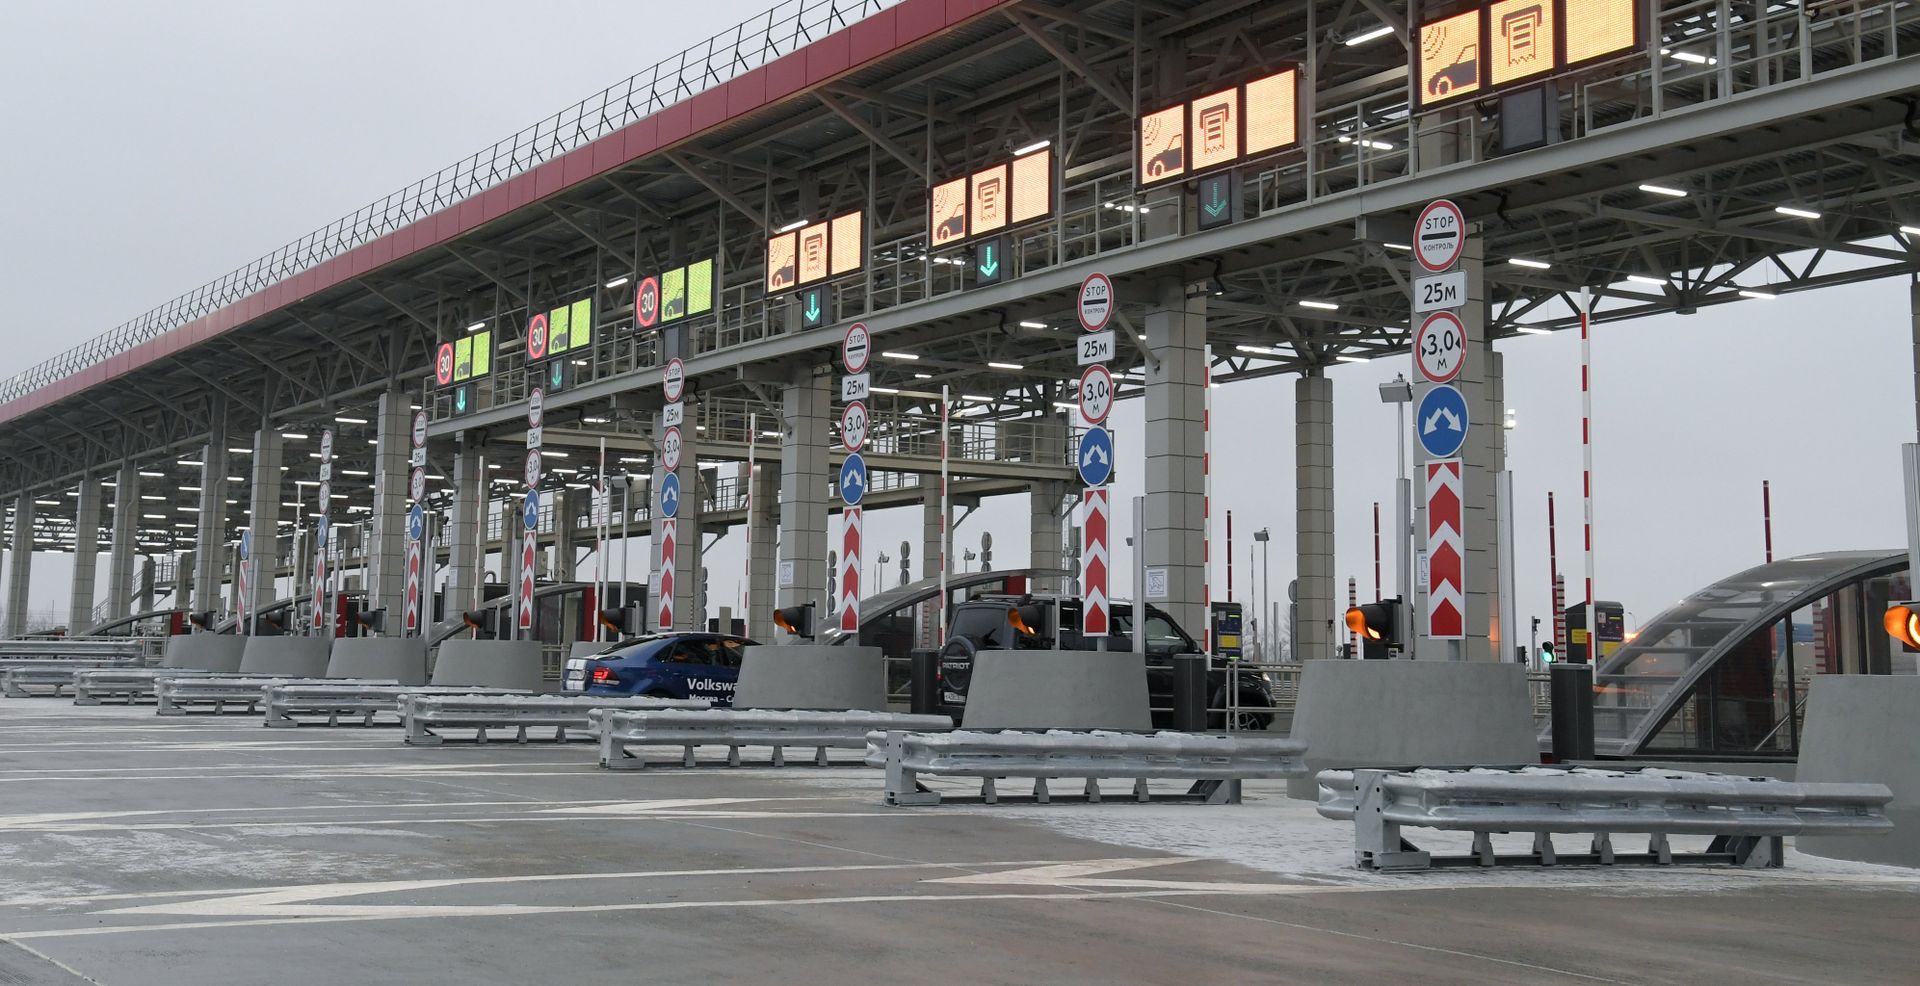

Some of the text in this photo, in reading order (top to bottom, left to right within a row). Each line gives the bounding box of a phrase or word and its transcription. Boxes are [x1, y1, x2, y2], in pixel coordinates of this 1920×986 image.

[1425, 215, 1454, 230] STOP
[1424, 243, 1454, 251] КОНТРОЛЬ
[1086, 286, 1106, 296] STOP
[641, 291, 654, 312] 30
[532, 327, 545, 346] 30
[849, 334, 865, 344] STOP
[1427, 330, 1454, 358] 3,0
[440, 355, 450, 373] 30
